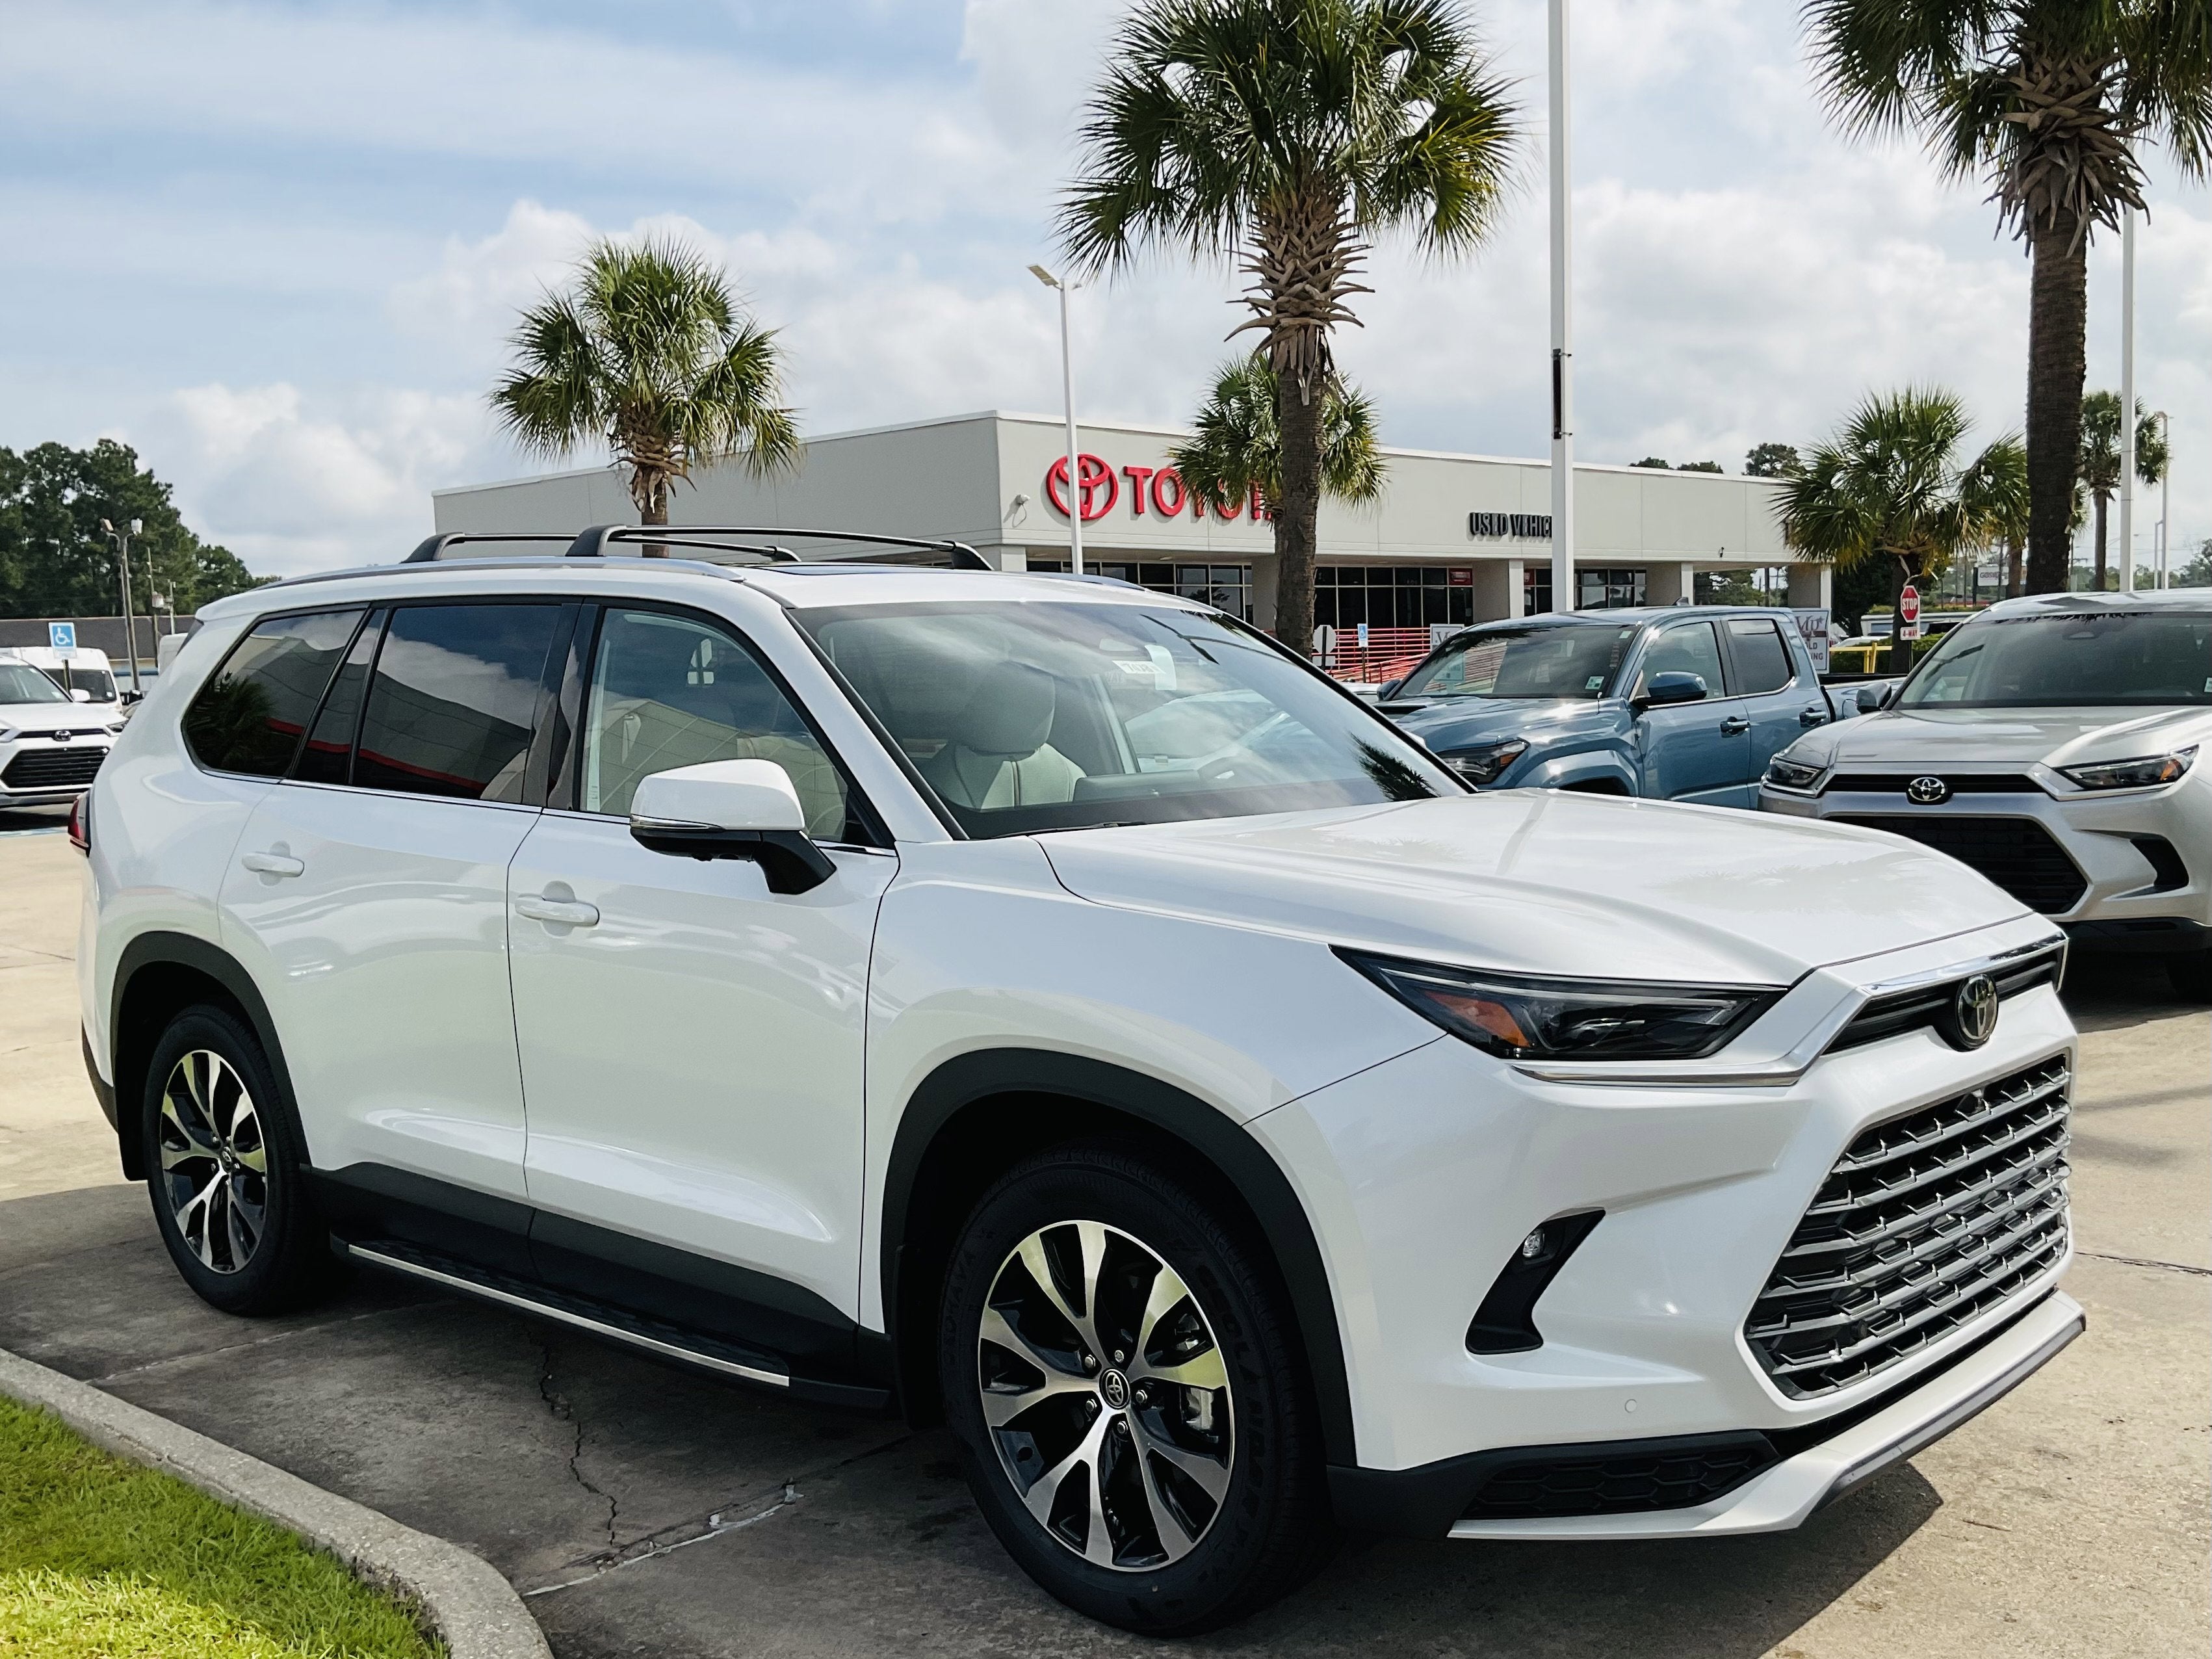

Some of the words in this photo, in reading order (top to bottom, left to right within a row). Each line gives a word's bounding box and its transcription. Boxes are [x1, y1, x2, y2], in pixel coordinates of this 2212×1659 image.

[1469, 512, 1509, 536] USED
[1509, 514, 1552, 538] VEHIC
[1902, 597, 1918, 610] STOP
[1902, 628, 1918, 638] 4-WAY
